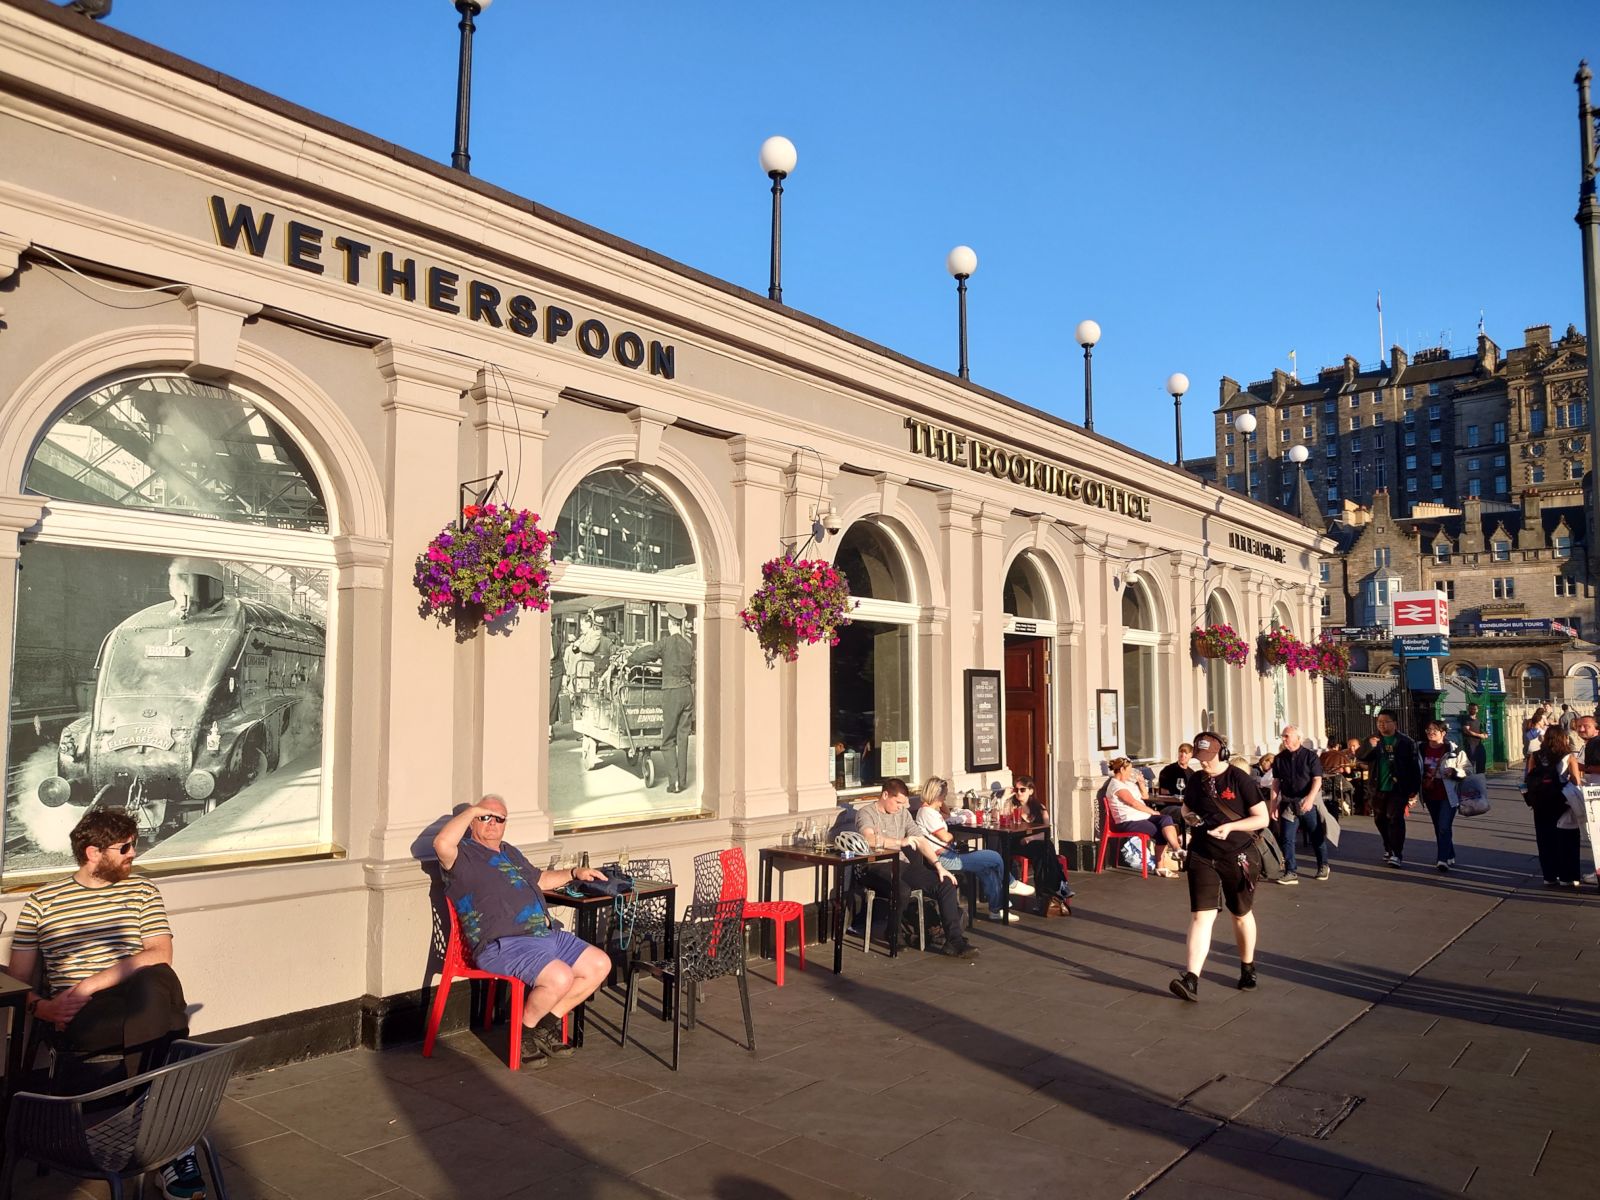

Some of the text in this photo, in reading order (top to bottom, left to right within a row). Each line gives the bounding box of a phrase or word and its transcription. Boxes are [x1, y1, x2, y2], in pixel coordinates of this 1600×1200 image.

[207, 195, 676, 380] WETHERSPOON
[904, 416, 1152, 523] THE BOOKING OFFICE
[109, 735, 170, 749] ELIZABETHAN
[134, 727, 153, 735] THE
